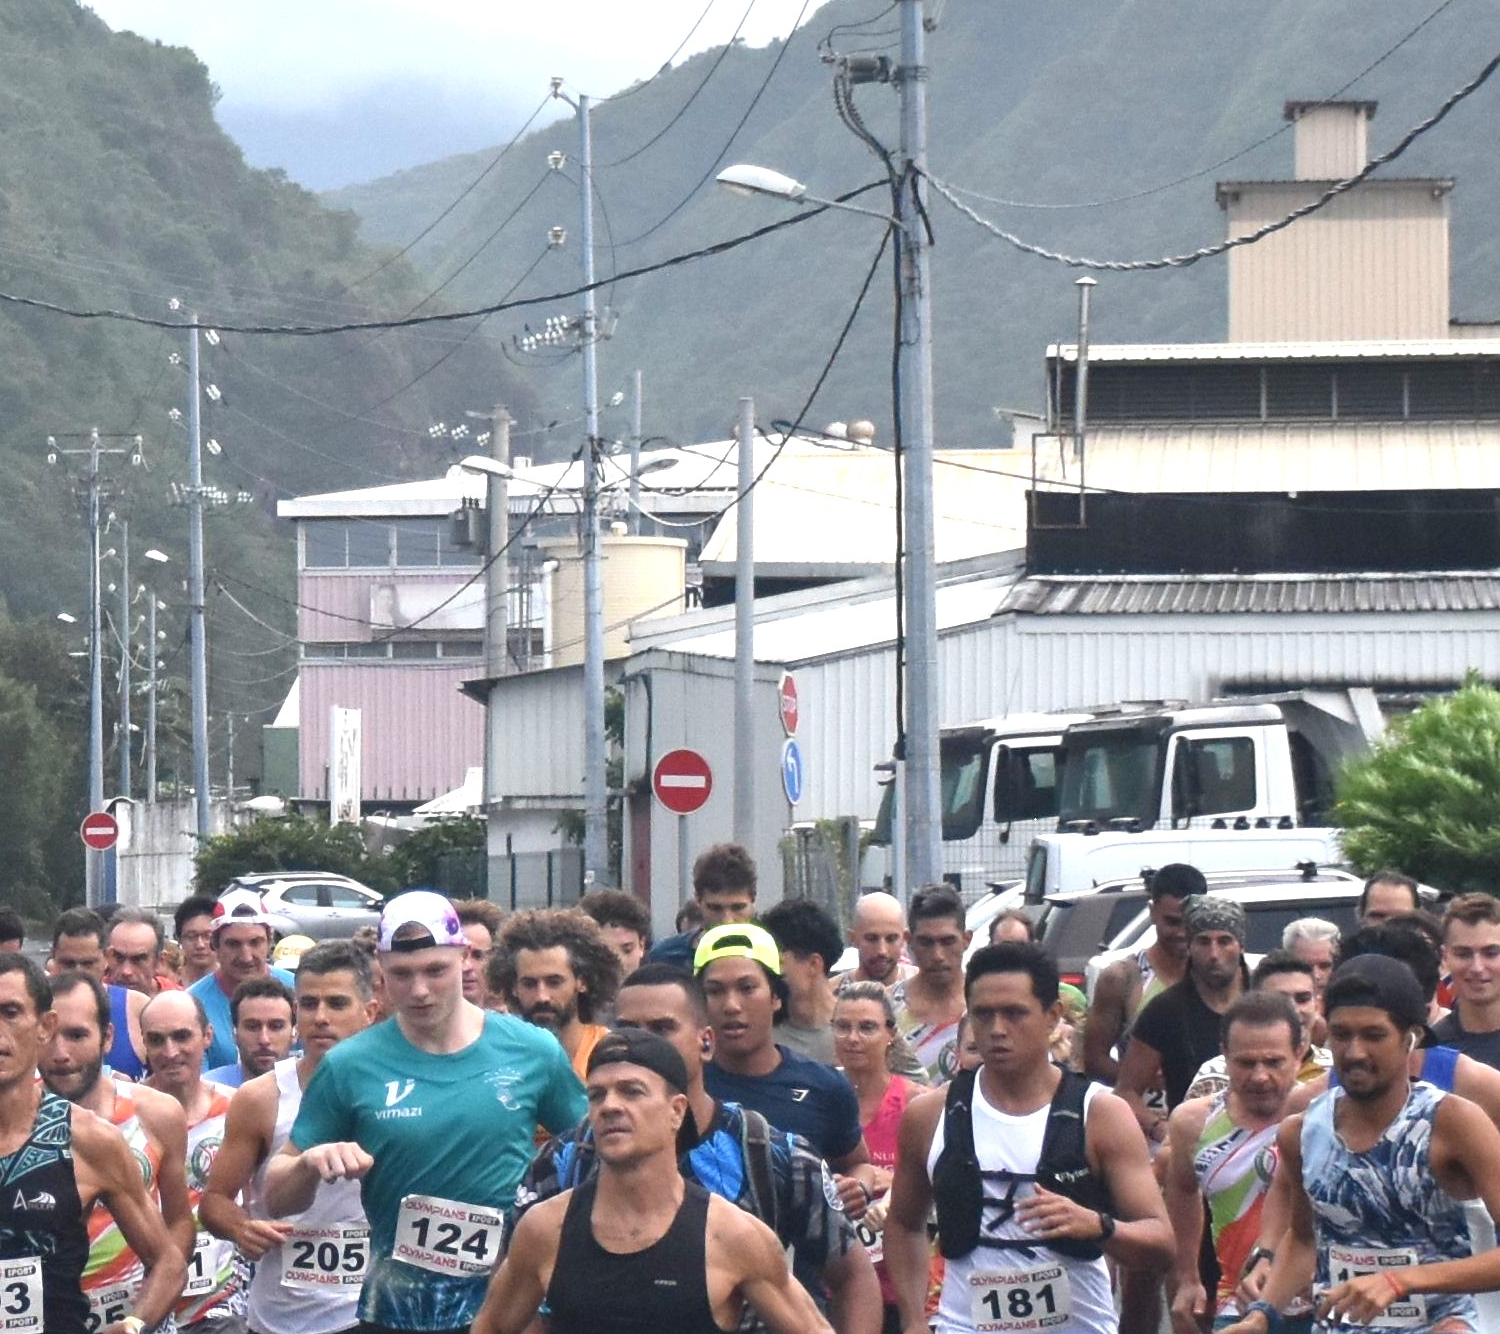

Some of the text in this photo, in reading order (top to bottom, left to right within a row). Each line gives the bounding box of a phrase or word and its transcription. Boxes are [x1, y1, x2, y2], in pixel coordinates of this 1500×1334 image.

[374, 1105, 422, 1120] vimazi
[405, 1200, 498, 1227] OLYMPIANS SPORT
[412, 1217, 489, 1260] 124
[292, 1241, 365, 1272] 205
[400, 1244, 458, 1269] OLYMPIANS
[1380, 1256, 1411, 1265] SPORT
[6, 1266, 34, 1277] SPORT
[286, 1271, 340, 1284] OLYMPIANS
[970, 1274, 1030, 1286] OLYMPIANS
[982, 1283, 1056, 1320] 181
[1389, 1308, 1417, 1317] SPORT
[8, 1317, 36, 1328] SPORT
[976, 1319, 1037, 1332] OLYMPIANS
